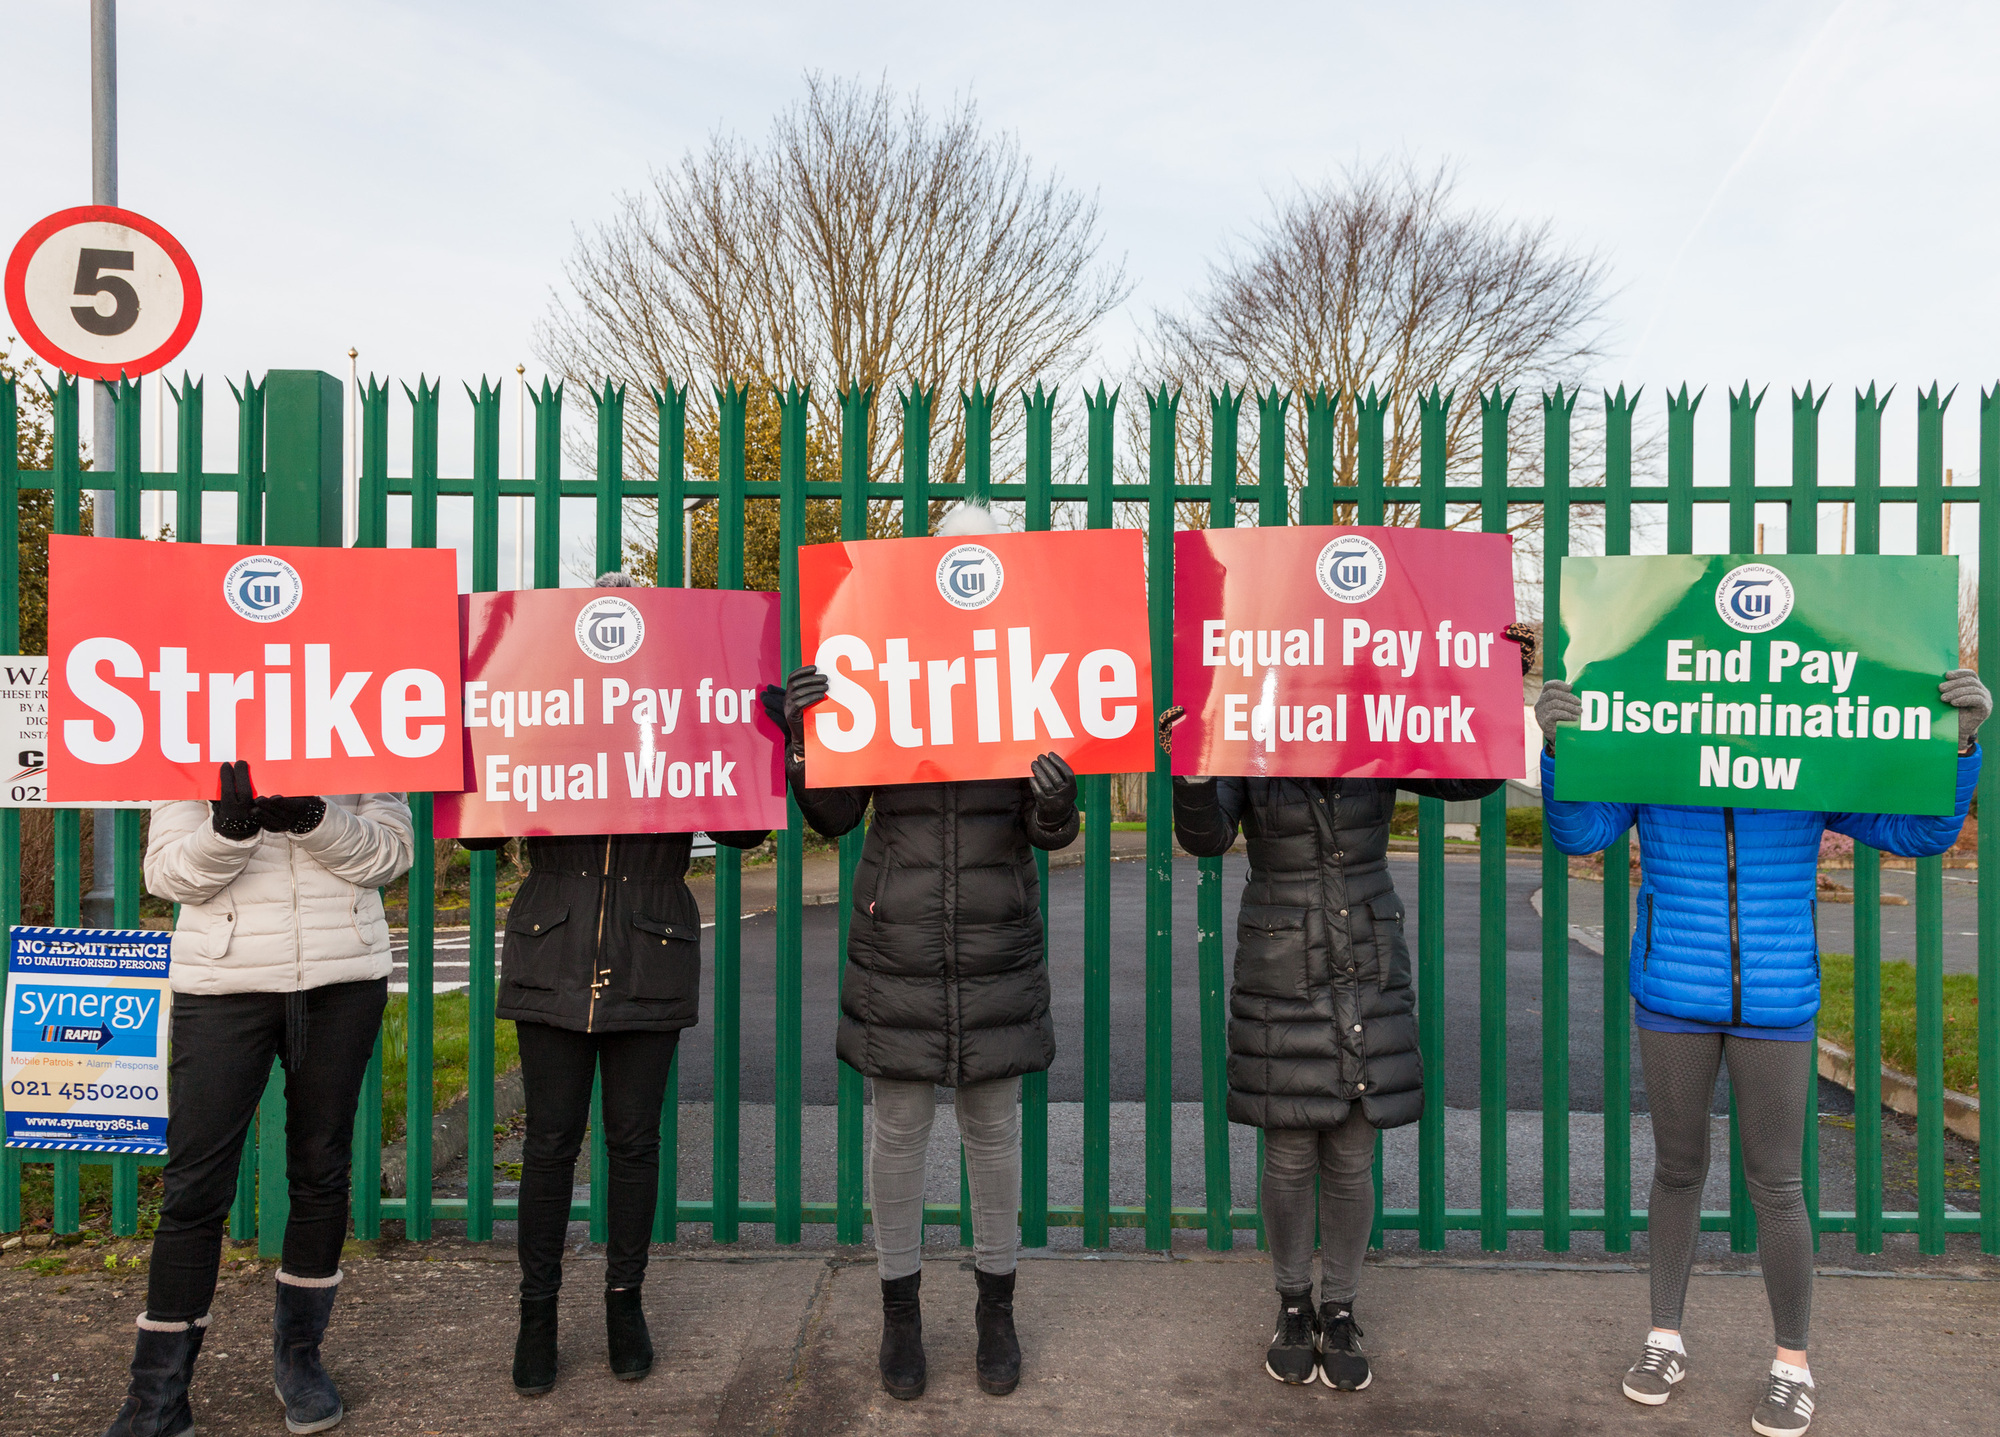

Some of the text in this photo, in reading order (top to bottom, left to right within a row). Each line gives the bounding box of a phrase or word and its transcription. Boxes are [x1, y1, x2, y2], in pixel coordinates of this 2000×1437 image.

[70, 248, 139, 336] 5
[986, 552, 1001, 576] IRELAND
[1369, 545, 1383, 570] IRELAND
[282, 566, 299, 590] IRELAND
[1320, 573, 1334, 594] AONTAS
[1775, 574, 1791, 599] IRELAND
[227, 592, 245, 613] AONTAS
[940, 582, 954, 602] AONTAS
[627, 606, 642, 630] IRELAND
[1719, 602, 1734, 623] AONTAS
[579, 634, 592, 654] AONTAS
[1202, 618, 1494, 678] Equal Pay for
[1666, 639, 1858, 693] End Pay
[63, 637, 446, 765] Strike
[814, 627, 1137, 752] Strike
[19, 703, 34, 712] BY
[464, 677, 756, 737] Equal Pay for
[1580, 690, 1931, 740] Discrimination
[1223, 694, 1476, 752] Equal Work
[1699, 745, 1802, 790] Now
[486, 751, 737, 812] Equal Work
[17, 939, 168, 958] NO ADMITTANCE
[17, 956, 166, 971] TO UNAUTHORISED PERSONS
[19, 991, 155, 1030] synergy
[64, 1029, 102, 1041] RAPID
[11, 1056, 40, 1065] Mobile
[42, 1057, 74, 1067] Patrols
[86, 1059, 112, 1068] Alarm
[115, 1060, 159, 1071] Response
[11, 1081, 159, 1101] 021 4550200
[25, 1117, 149, 1131] www.synergy365.ie
